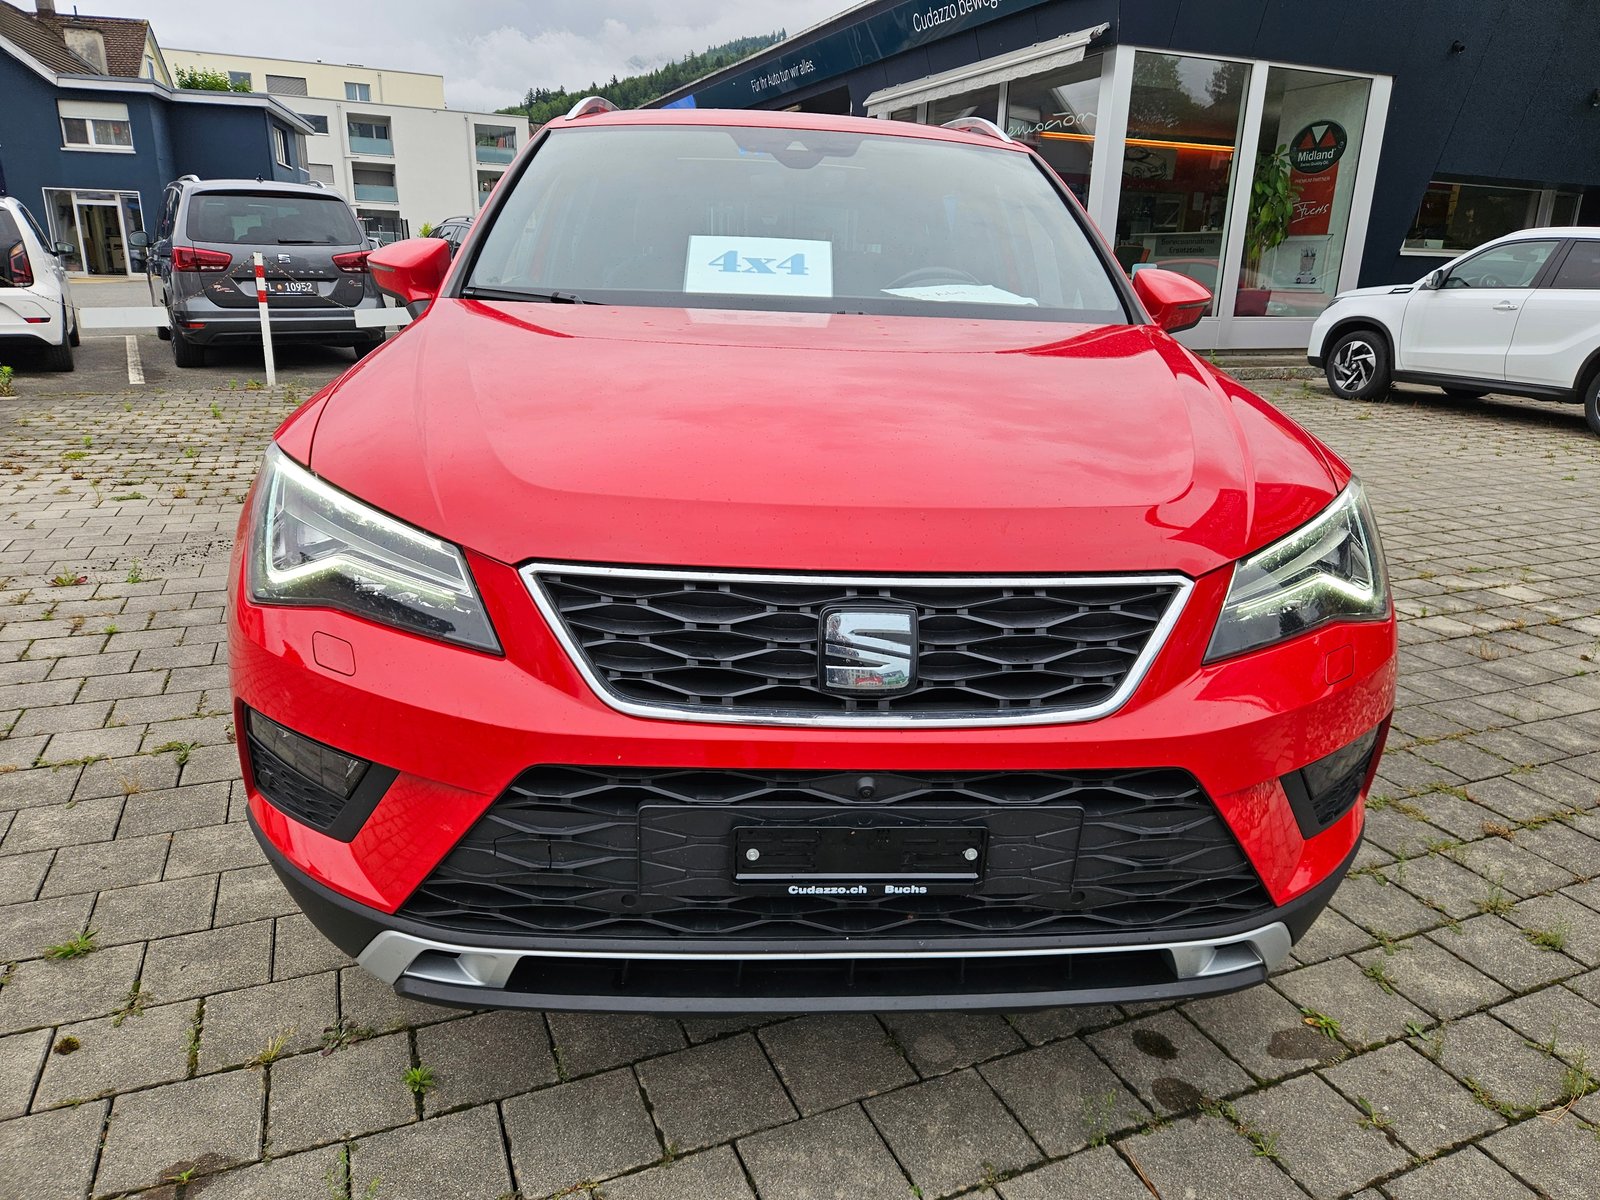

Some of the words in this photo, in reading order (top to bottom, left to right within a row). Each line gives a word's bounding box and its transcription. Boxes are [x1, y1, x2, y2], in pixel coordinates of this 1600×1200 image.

[912, 4, 957, 32] Cudazzo
[750, 79, 760, 93] Für
[768, 73, 780, 88] Auto
[780, 69, 790, 82] tun
[789, 63, 799, 78] wir
[1297, 149, 1335, 162] Midland
[708, 250, 808, 275] 4x4
[285, 282, 313, 292] 10952
[788, 885, 867, 894] Cudazzo.ch
[884, 885, 927, 894] Buchs
